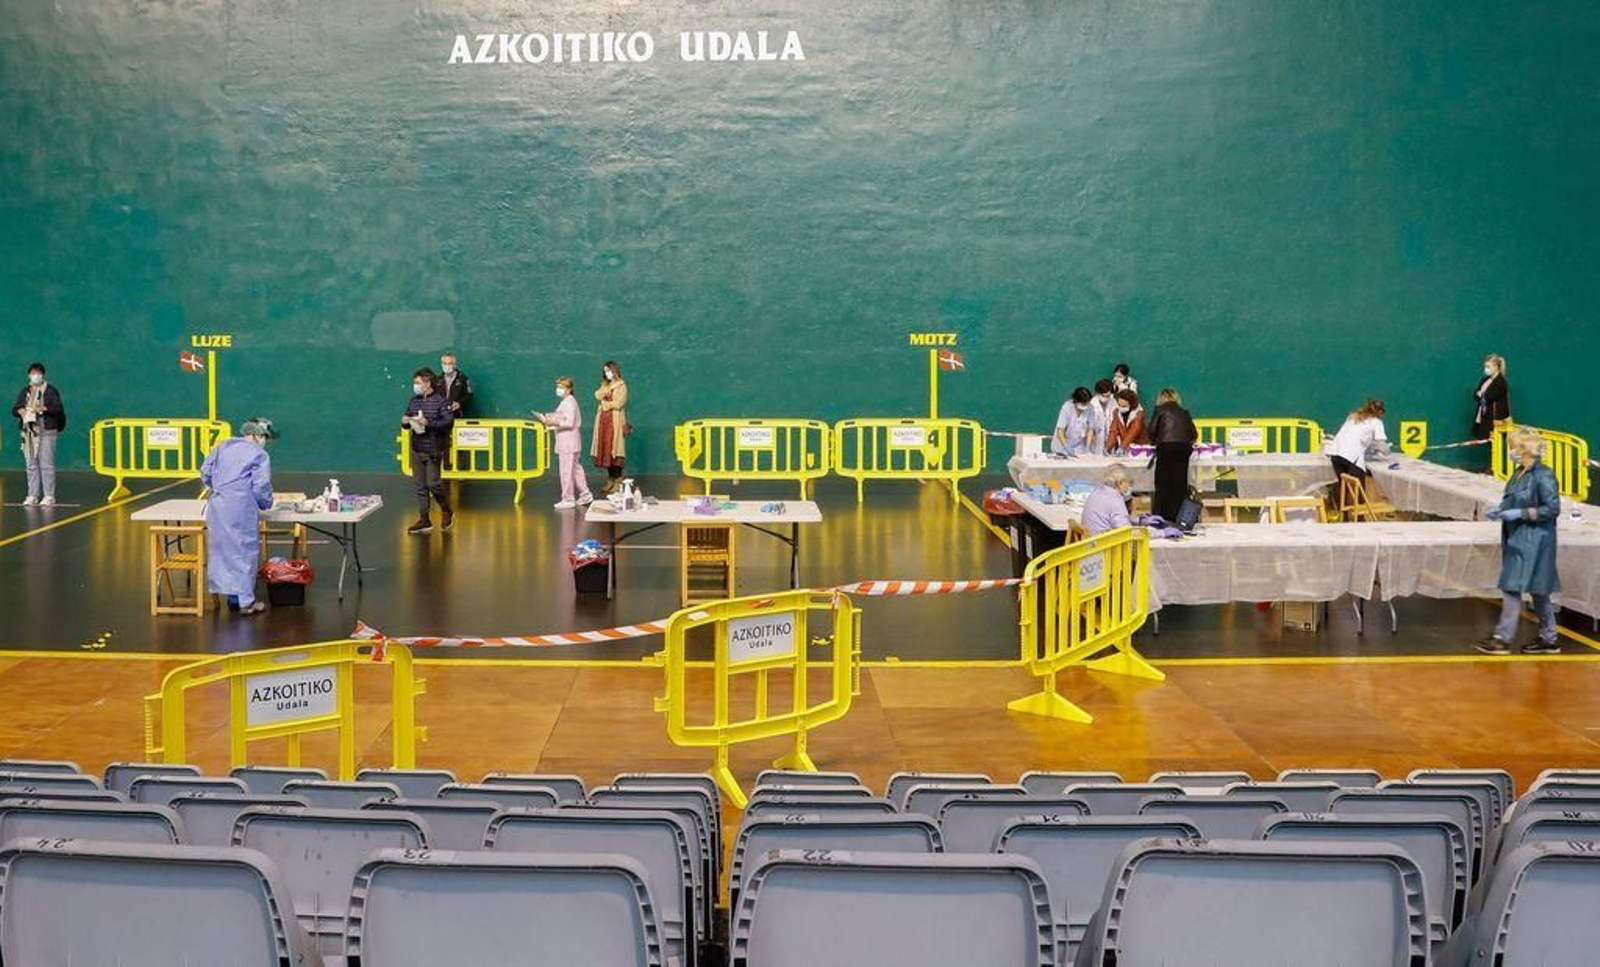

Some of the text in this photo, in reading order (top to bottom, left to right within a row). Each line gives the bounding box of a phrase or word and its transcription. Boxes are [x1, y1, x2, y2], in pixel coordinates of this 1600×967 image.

[448, 30, 805, 64] AZKOITIKO UDALA
[191, 335, 232, 347] LUZE
[910, 333, 957, 346] MOTZ
[209, 429, 220, 447] 7
[928, 430, 939, 448] 4
[1406, 426, 1421, 444] 2
[732, 622, 791, 642] AZKOITIKO
[749, 639, 773, 649] Udala
[251, 679, 333, 703] AZKOITIKO
[277, 700, 309, 711] Udala
[404, 847, 431, 860] 23
[803, 850, 833, 862] 22
